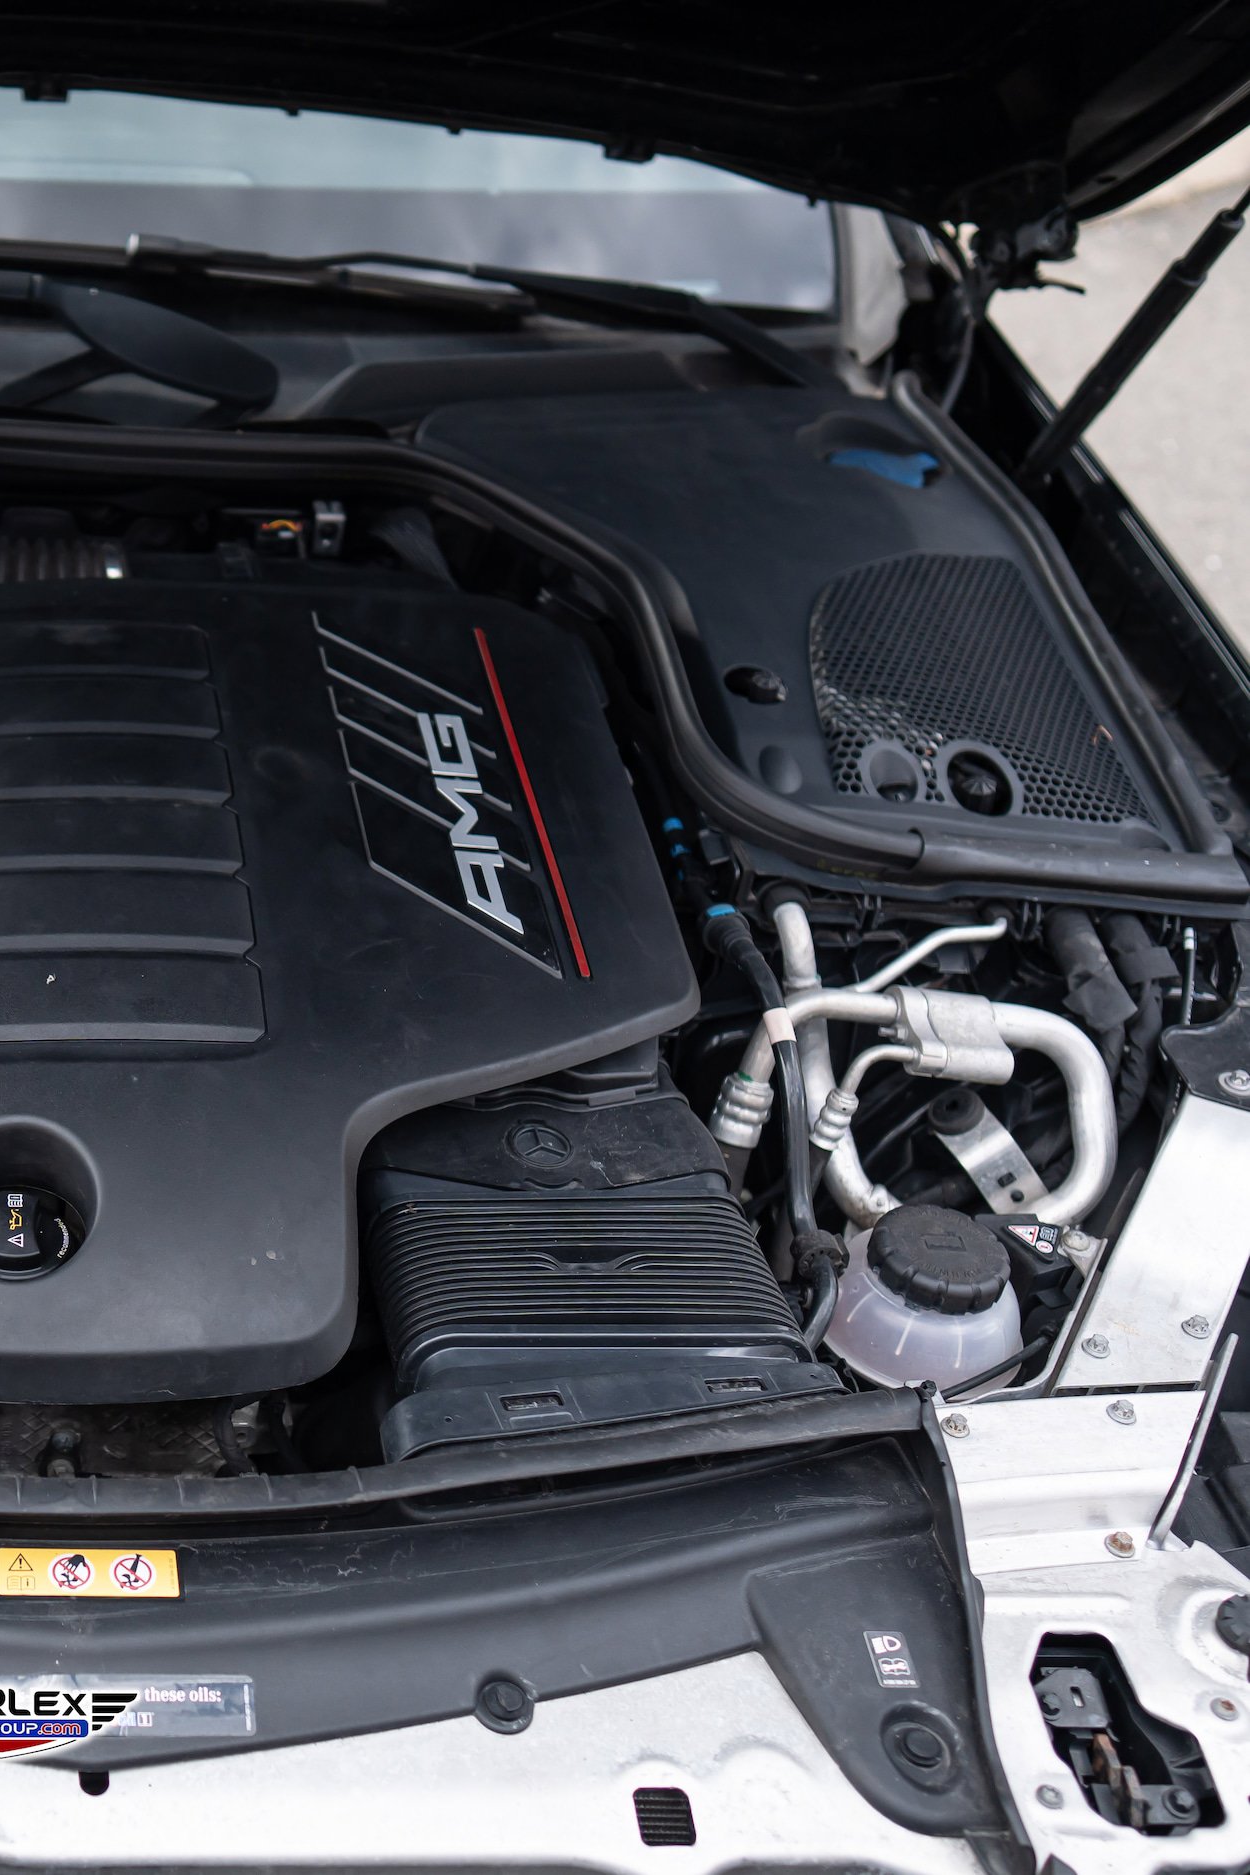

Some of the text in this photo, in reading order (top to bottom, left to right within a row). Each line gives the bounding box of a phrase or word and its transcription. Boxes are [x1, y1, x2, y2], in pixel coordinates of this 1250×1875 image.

[416, 712, 524, 935] AMG
[144, 1686, 222, 1702] these oils:
